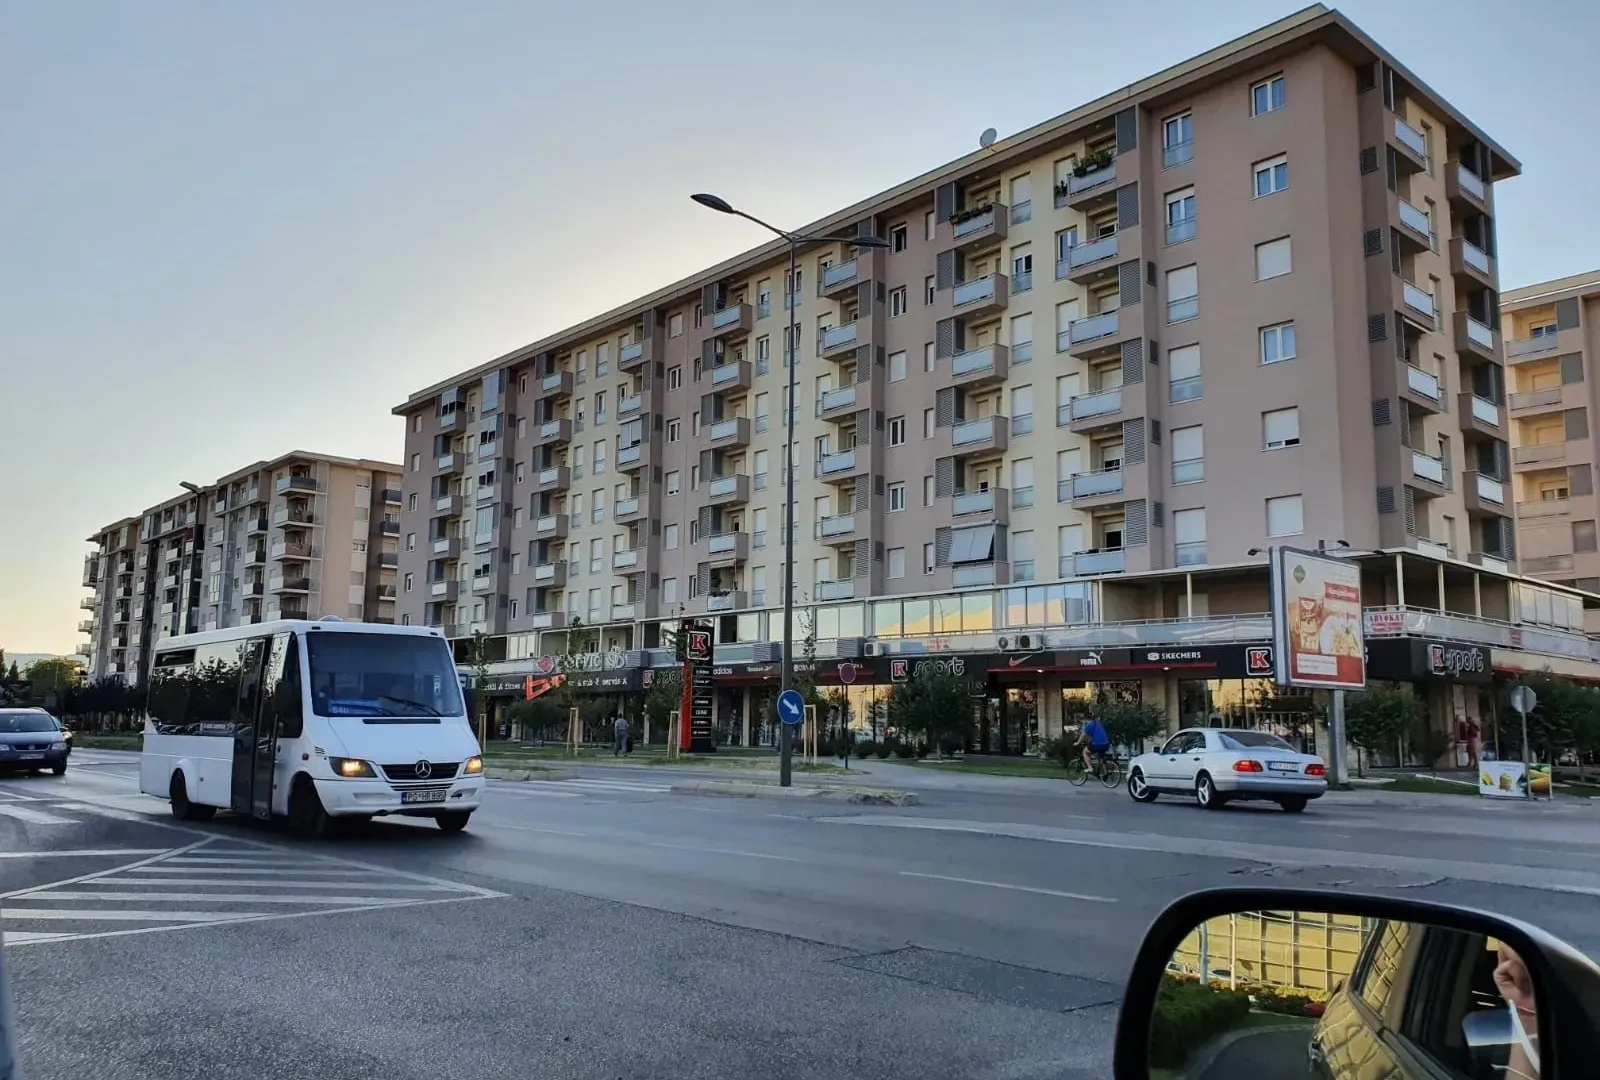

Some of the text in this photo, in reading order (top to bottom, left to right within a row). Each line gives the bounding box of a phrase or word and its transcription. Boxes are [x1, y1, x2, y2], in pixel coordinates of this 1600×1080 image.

[1369, 612, 1405, 623] ADVOKAT
[691, 633, 706, 650] K
[1161, 651, 1201, 660] SKECHERS
[1250, 650, 1270, 668] K
[1433, 647, 1484, 678] K sport
[893, 662, 906, 677] K
